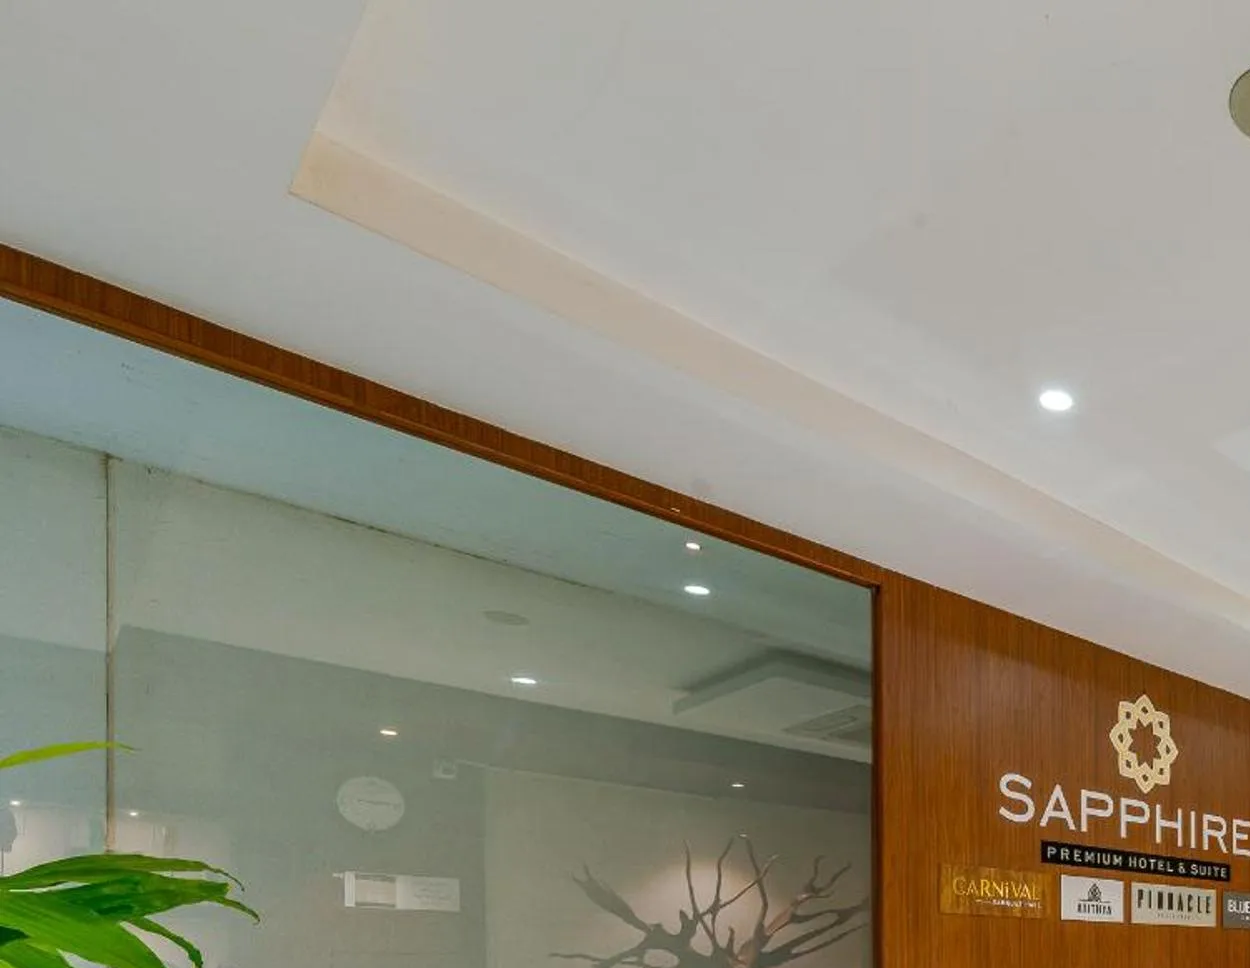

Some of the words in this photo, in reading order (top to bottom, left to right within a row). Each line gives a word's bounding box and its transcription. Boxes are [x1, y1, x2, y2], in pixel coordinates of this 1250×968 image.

[1046, 845, 1123, 867] PREMIUM
[1128, 855, 1174, 874] HOTEL
[1178, 863, 1187, 875] &
[1190, 863, 1228, 879] SUITE
[1137, 888, 1212, 914] PINNACLE
